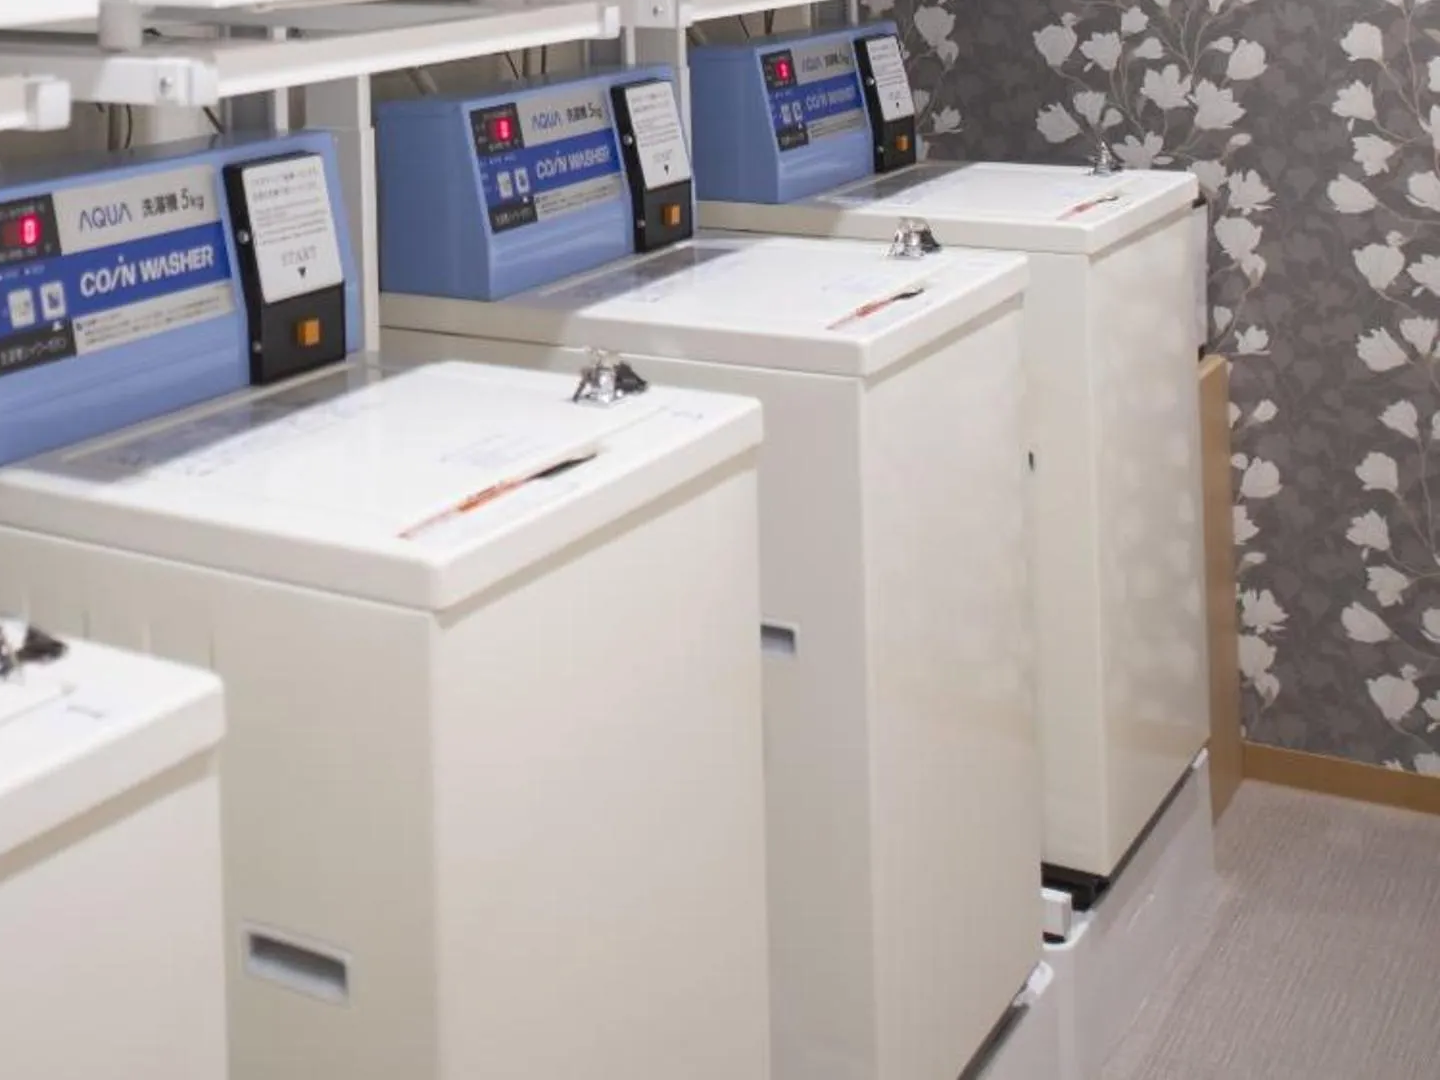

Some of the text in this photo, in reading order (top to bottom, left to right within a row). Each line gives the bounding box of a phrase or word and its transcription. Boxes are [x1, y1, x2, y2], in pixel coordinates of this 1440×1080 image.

[79, 201, 132, 232] AQUA
[180, 187, 205, 211] 5kg
[139, 244, 214, 283] WASHER
